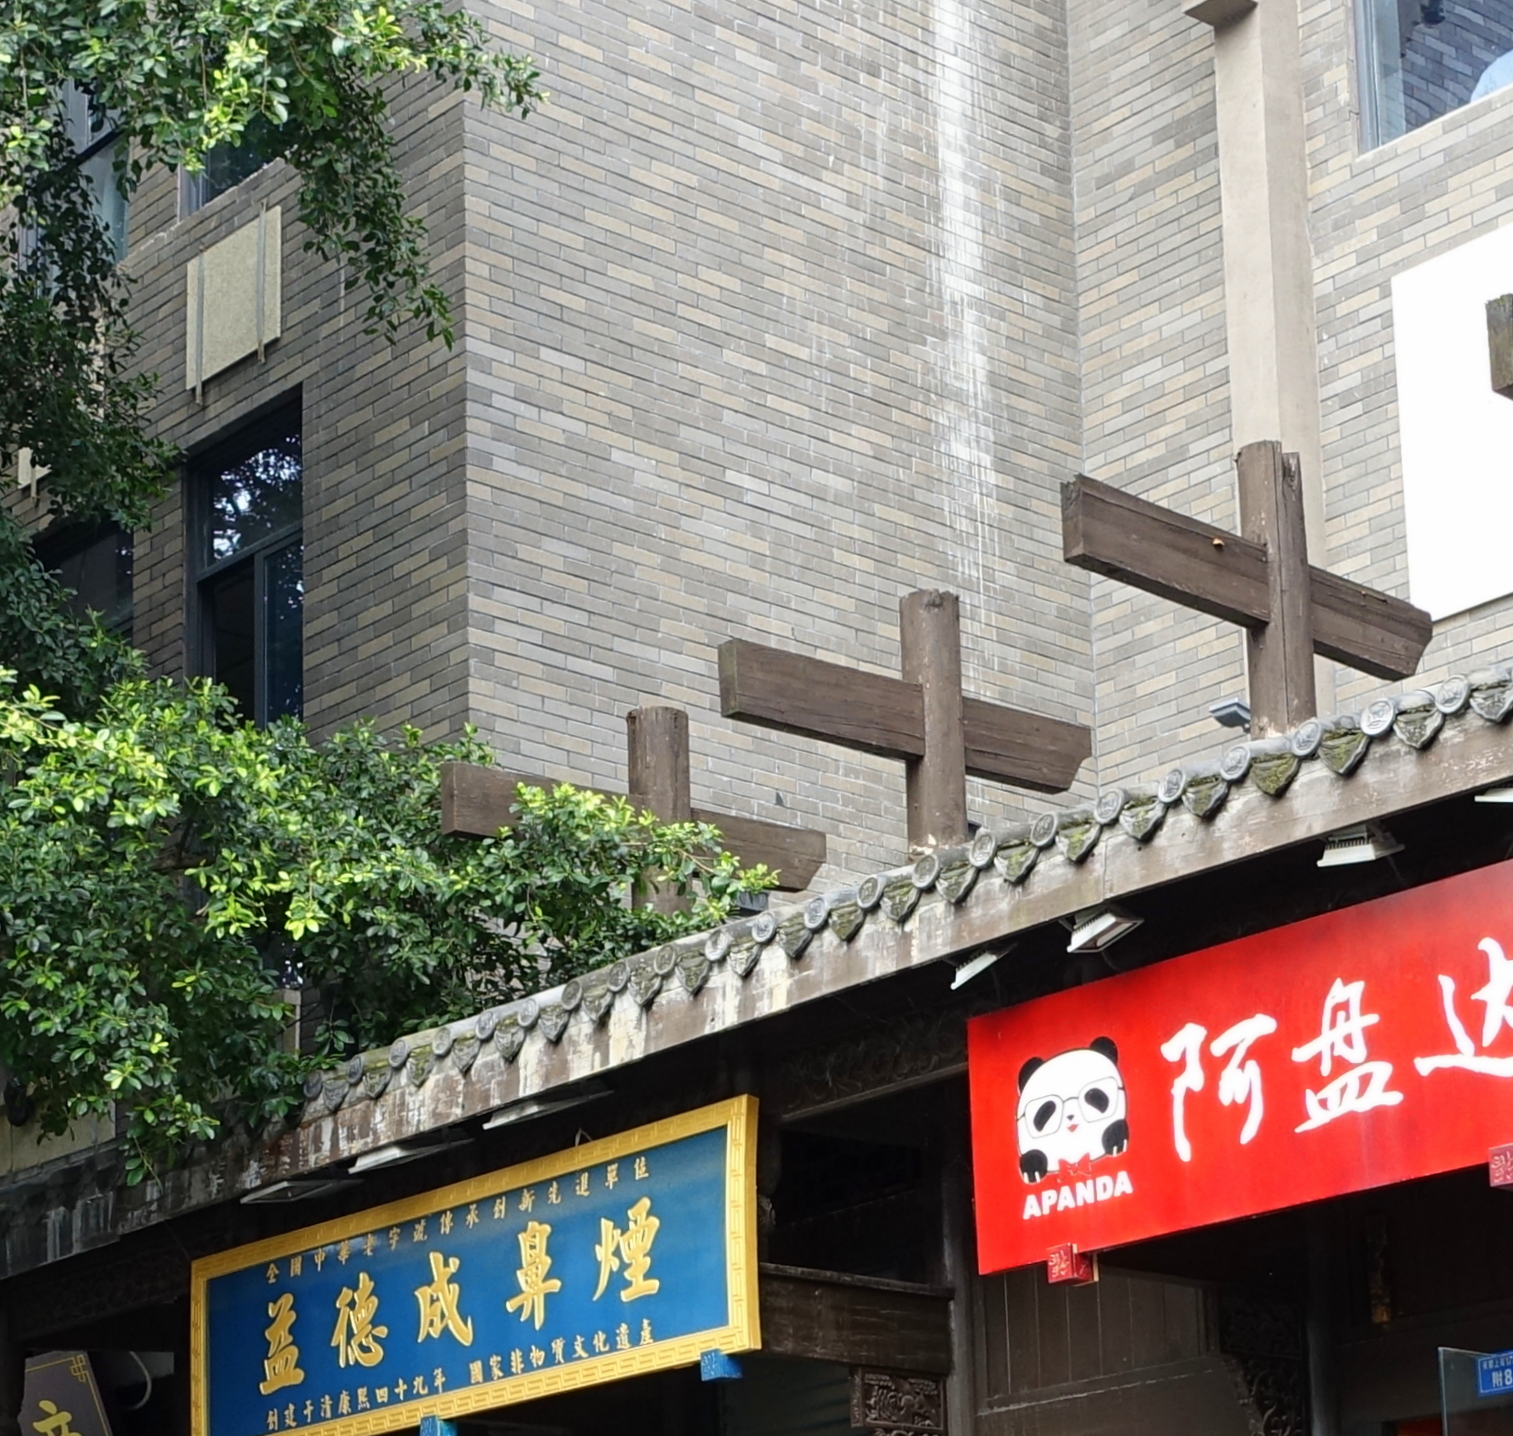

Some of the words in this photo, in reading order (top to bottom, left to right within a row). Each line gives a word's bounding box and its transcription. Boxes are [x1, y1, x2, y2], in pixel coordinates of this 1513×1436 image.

[1021, 1170, 1135, 1221] APANDA
[258, 1195, 661, 1396] 益德成鼻煙
